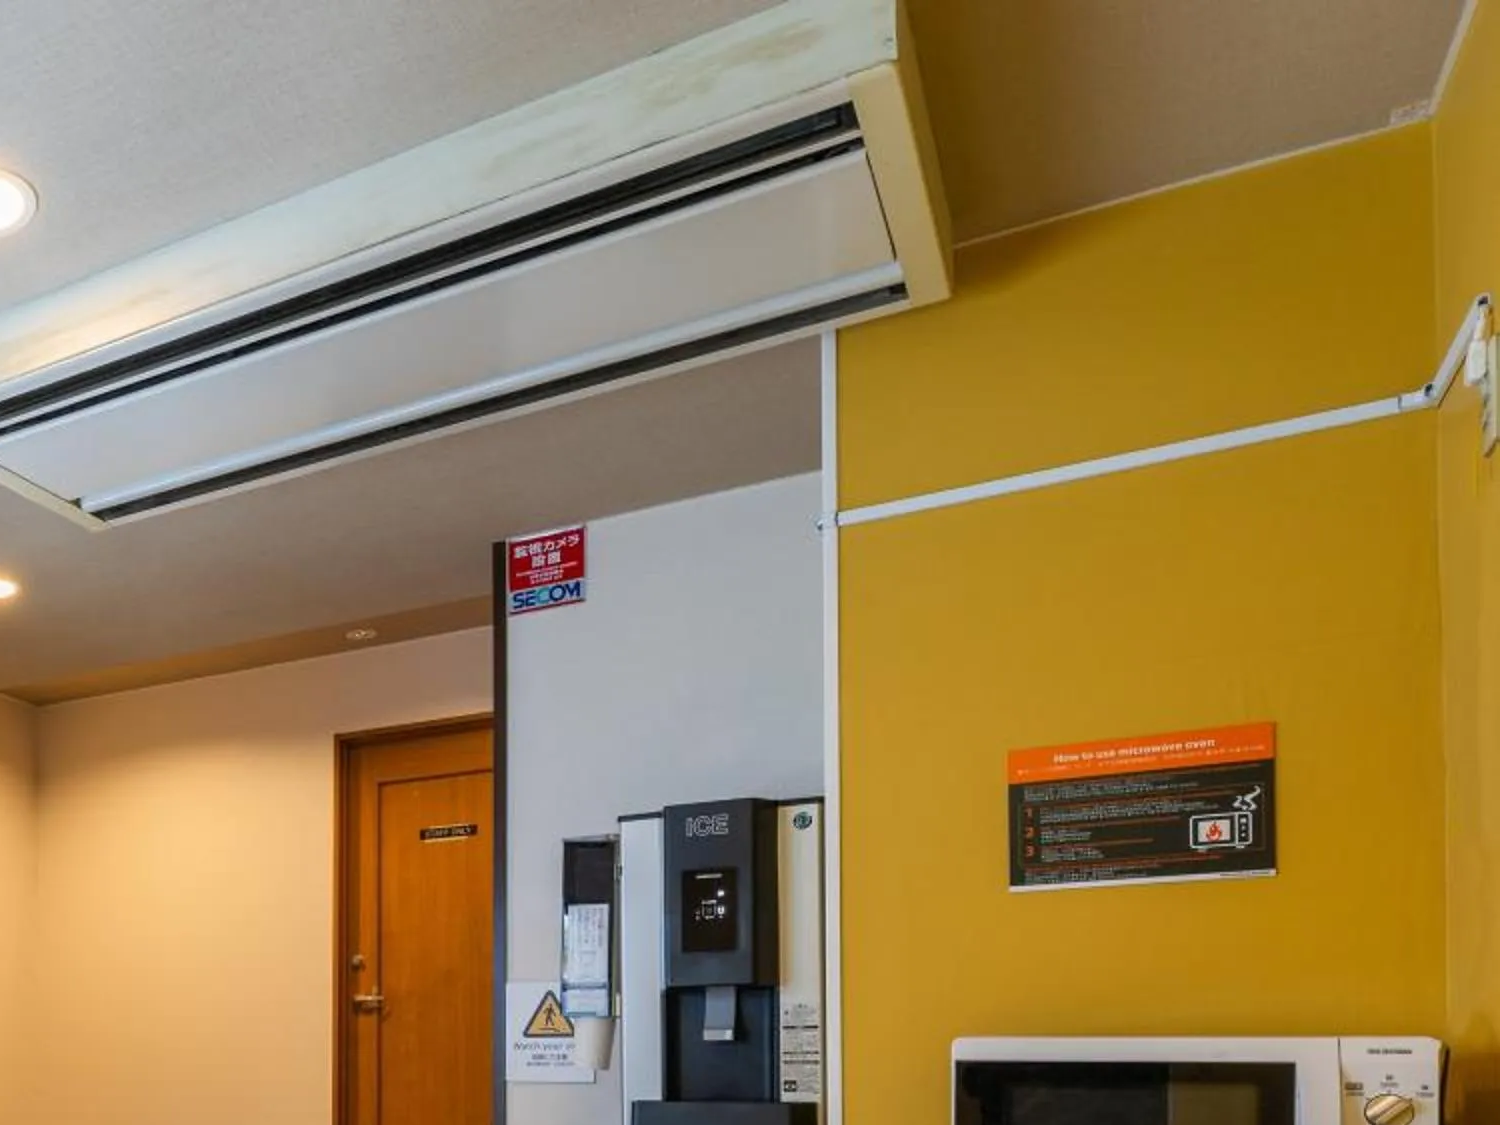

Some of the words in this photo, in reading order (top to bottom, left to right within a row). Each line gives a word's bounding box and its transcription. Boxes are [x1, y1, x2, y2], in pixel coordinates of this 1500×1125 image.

[513, 580, 581, 609] SECOM
[1054, 752, 1079, 764] How
[1117, 741, 1183, 758] microwave
[685, 813, 729, 837] ICE
